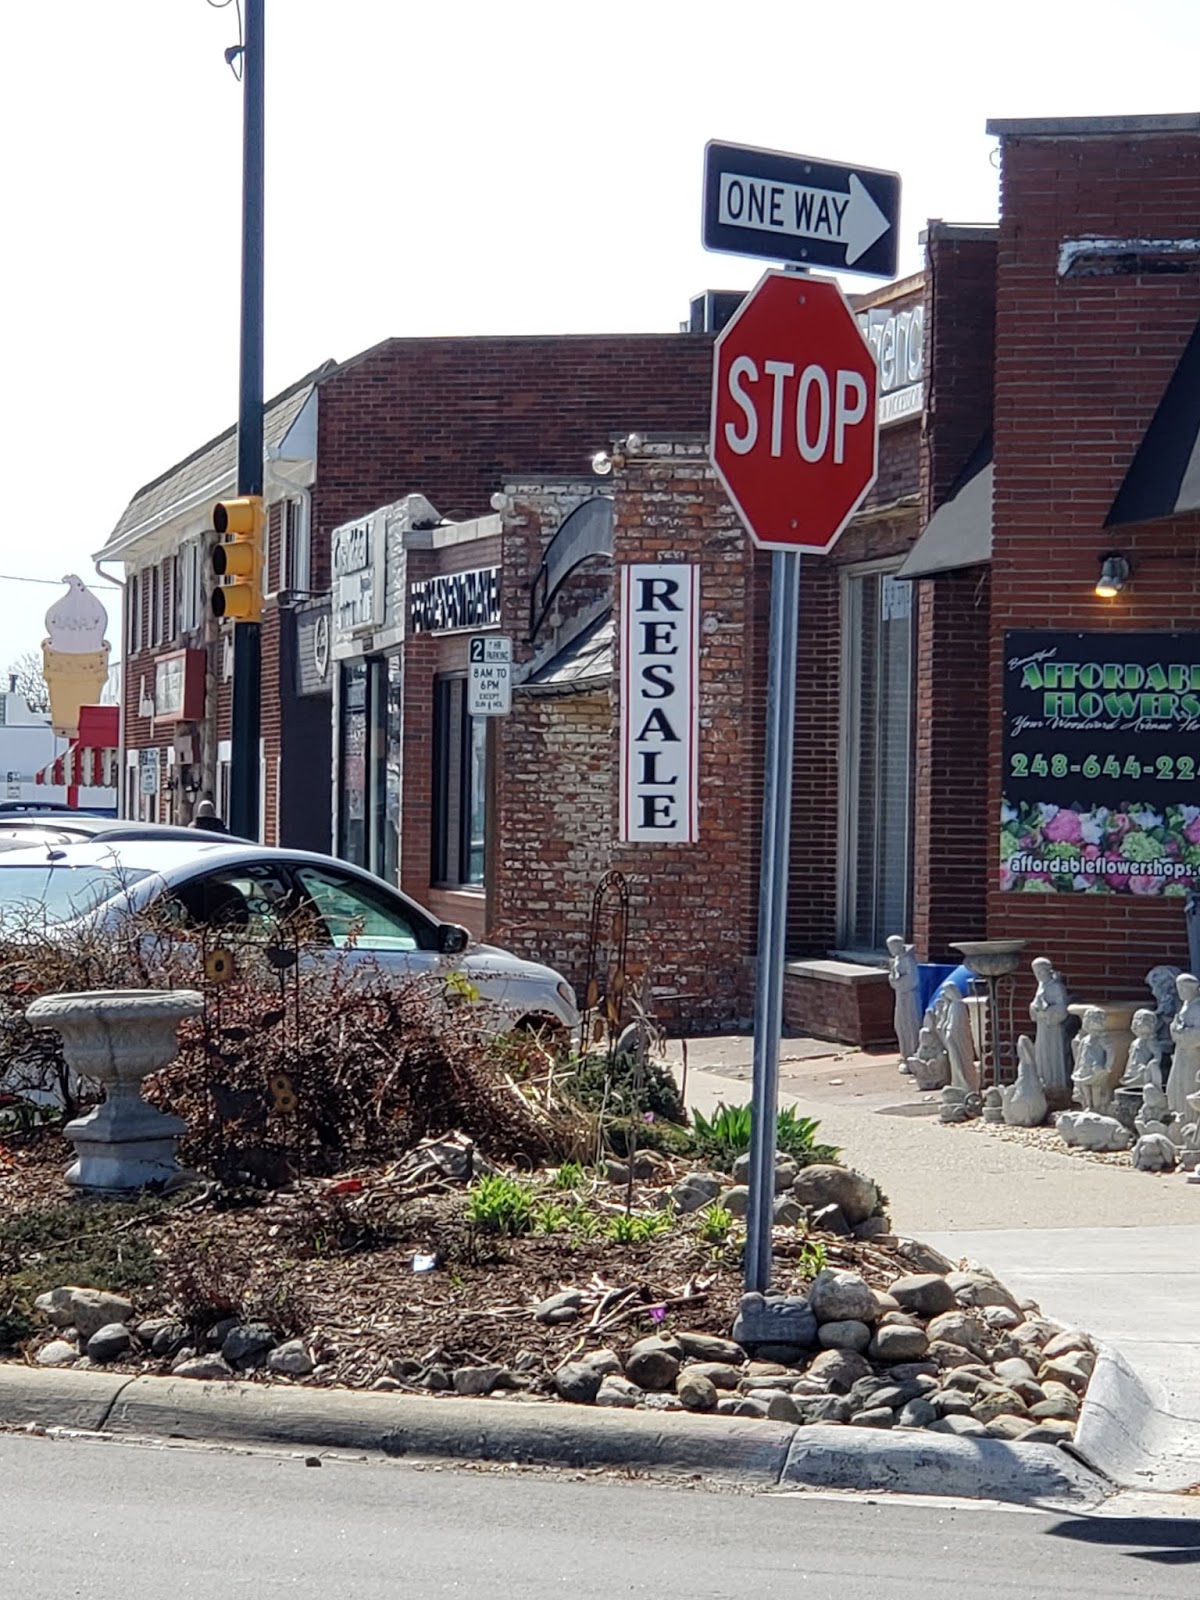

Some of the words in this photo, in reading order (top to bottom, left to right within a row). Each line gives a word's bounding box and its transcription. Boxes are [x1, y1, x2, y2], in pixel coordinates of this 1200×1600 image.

[727, 180, 784, 227] ONE
[795, 191, 850, 237] WAY
[724, 355, 868, 464] STOP
[473, 641, 482, 660] 2
[496, 668, 507, 678] TO
[635, 577, 684, 829] RESALE
[1044, 692, 1200, 720] FLOWERS
[1010, 715, 1043, 737] Your
[1045, 717, 1120, 730] Woodward
[1120, 717, 1173, 733] Avenue
[1011, 753, 1200, 780] 248-644-22
[1011, 856, 1200, 879] affordableflowershops.
